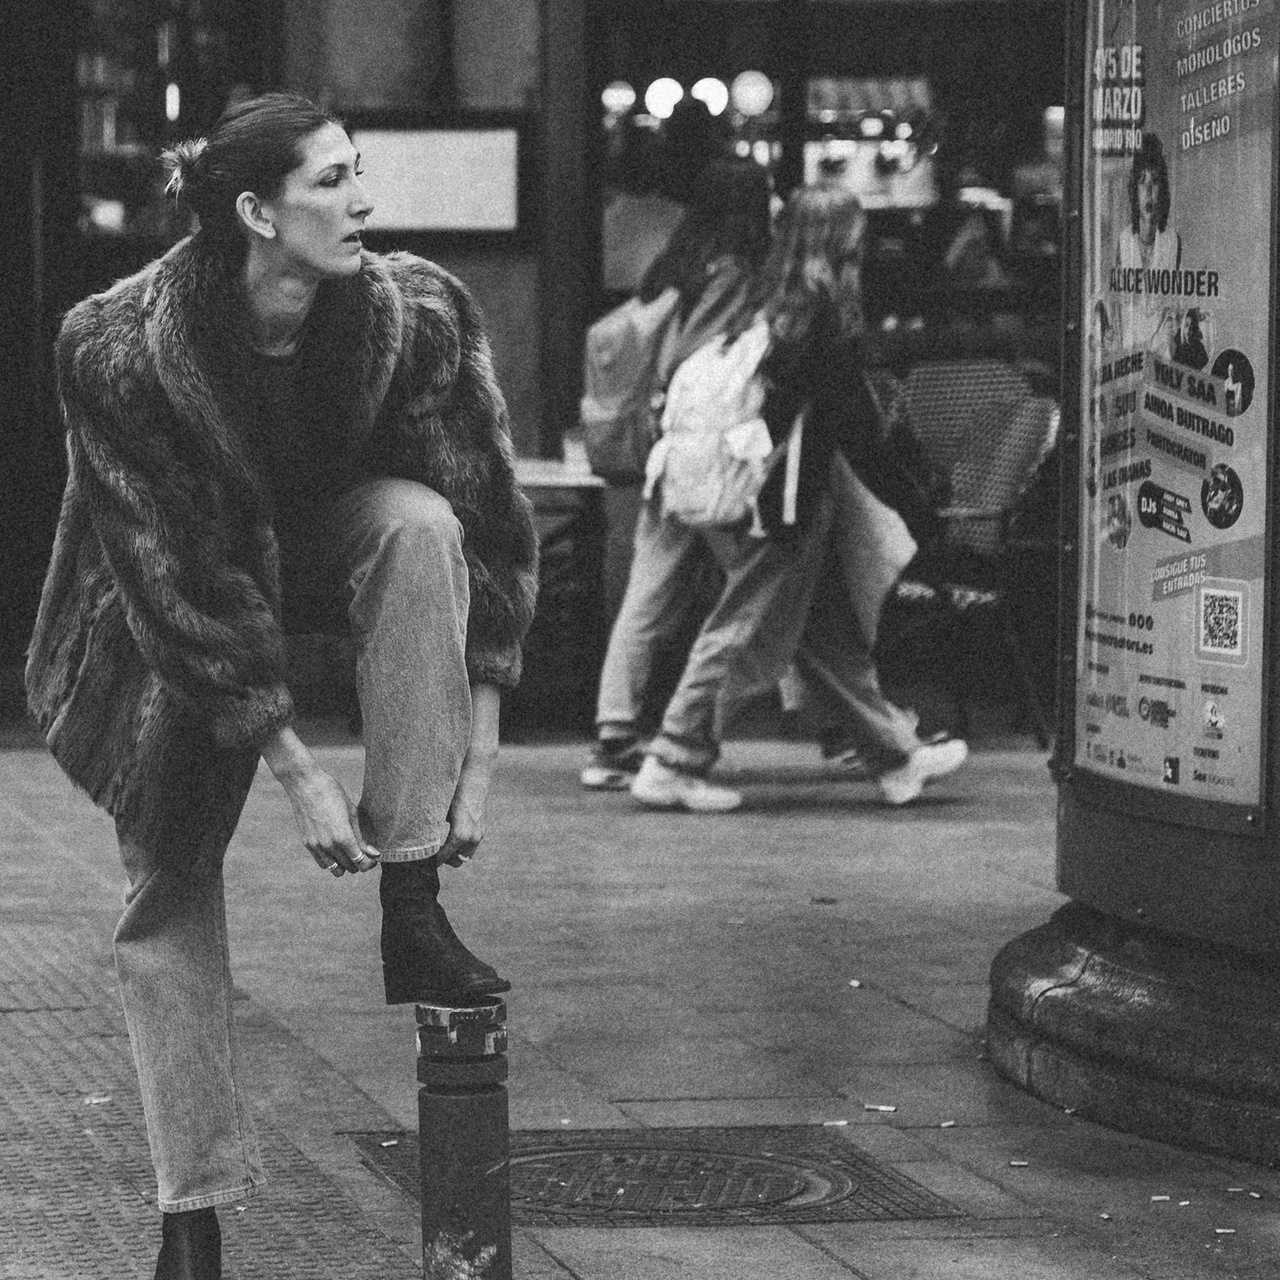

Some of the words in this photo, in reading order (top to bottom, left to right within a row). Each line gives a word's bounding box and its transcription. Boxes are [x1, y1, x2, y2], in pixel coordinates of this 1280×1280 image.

[1121, 46, 1142, 79] DE
[1180, 72, 1246, 112] TALLERES
[1109, 268, 1143, 294] ALICE
[1147, 269, 1218, 297] WONDER
[1176, 407, 1234, 447] BUITRAGO
[1141, 497, 1157, 514] DJs
